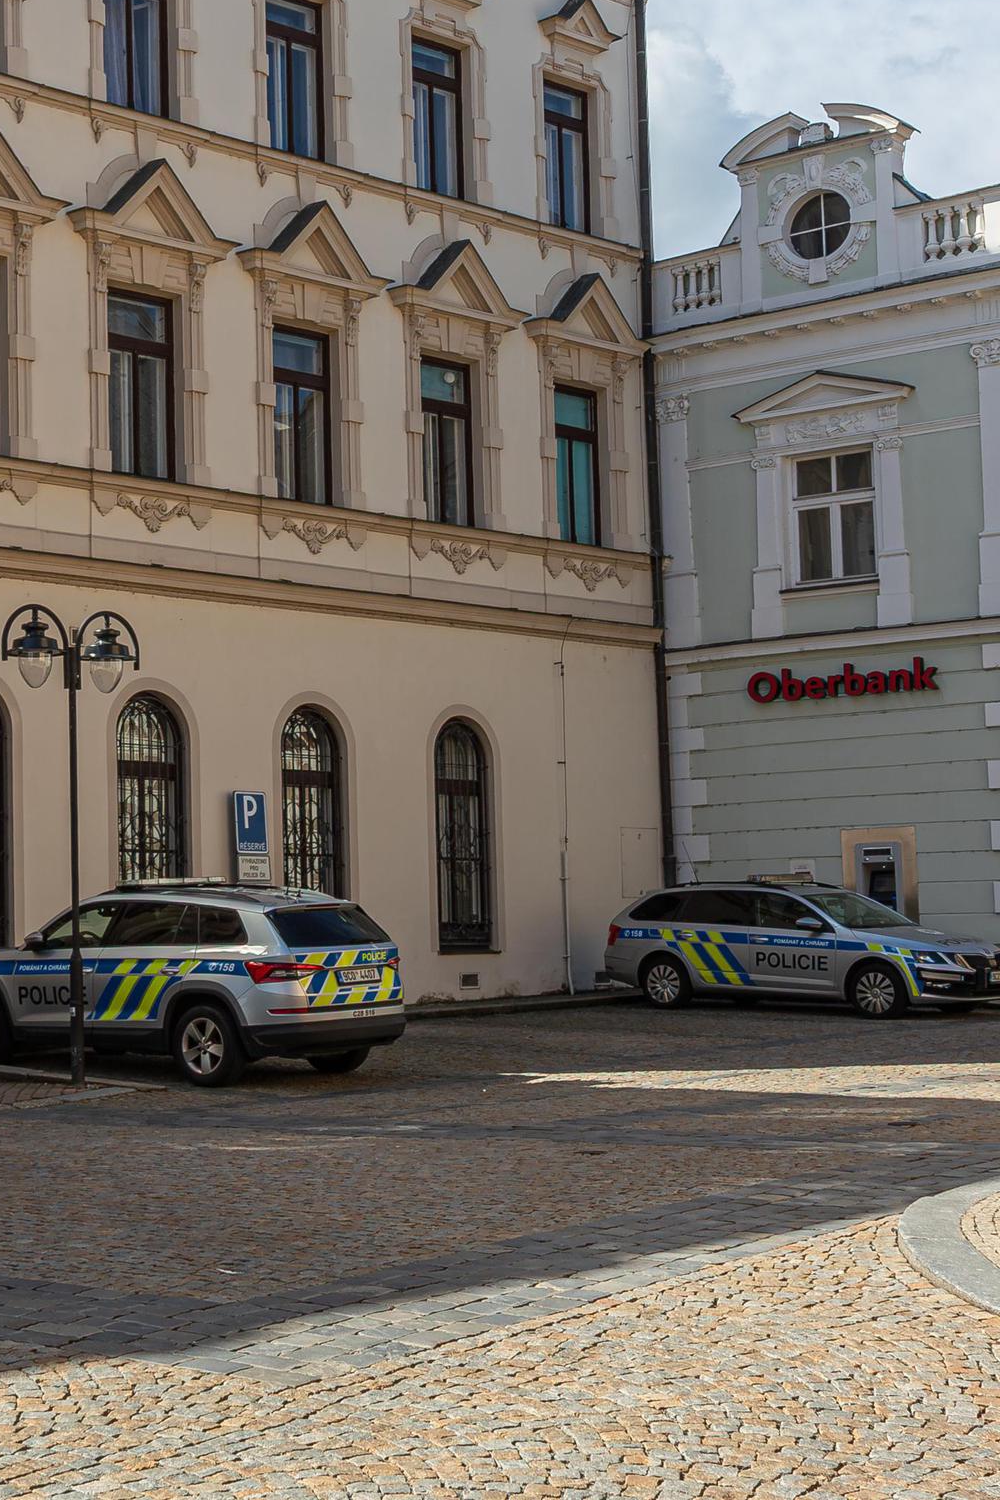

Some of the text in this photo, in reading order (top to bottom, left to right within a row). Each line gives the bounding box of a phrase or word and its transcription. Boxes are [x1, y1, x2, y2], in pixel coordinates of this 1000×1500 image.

[747, 656, 940, 704] Oberbank
[243, 795, 258, 829] P
[362, 951, 387, 961] POLICIE
[755, 951, 829, 971] POLICIE
[218, 962, 235, 972] 158
[18, 986, 88, 1005] POLICE
